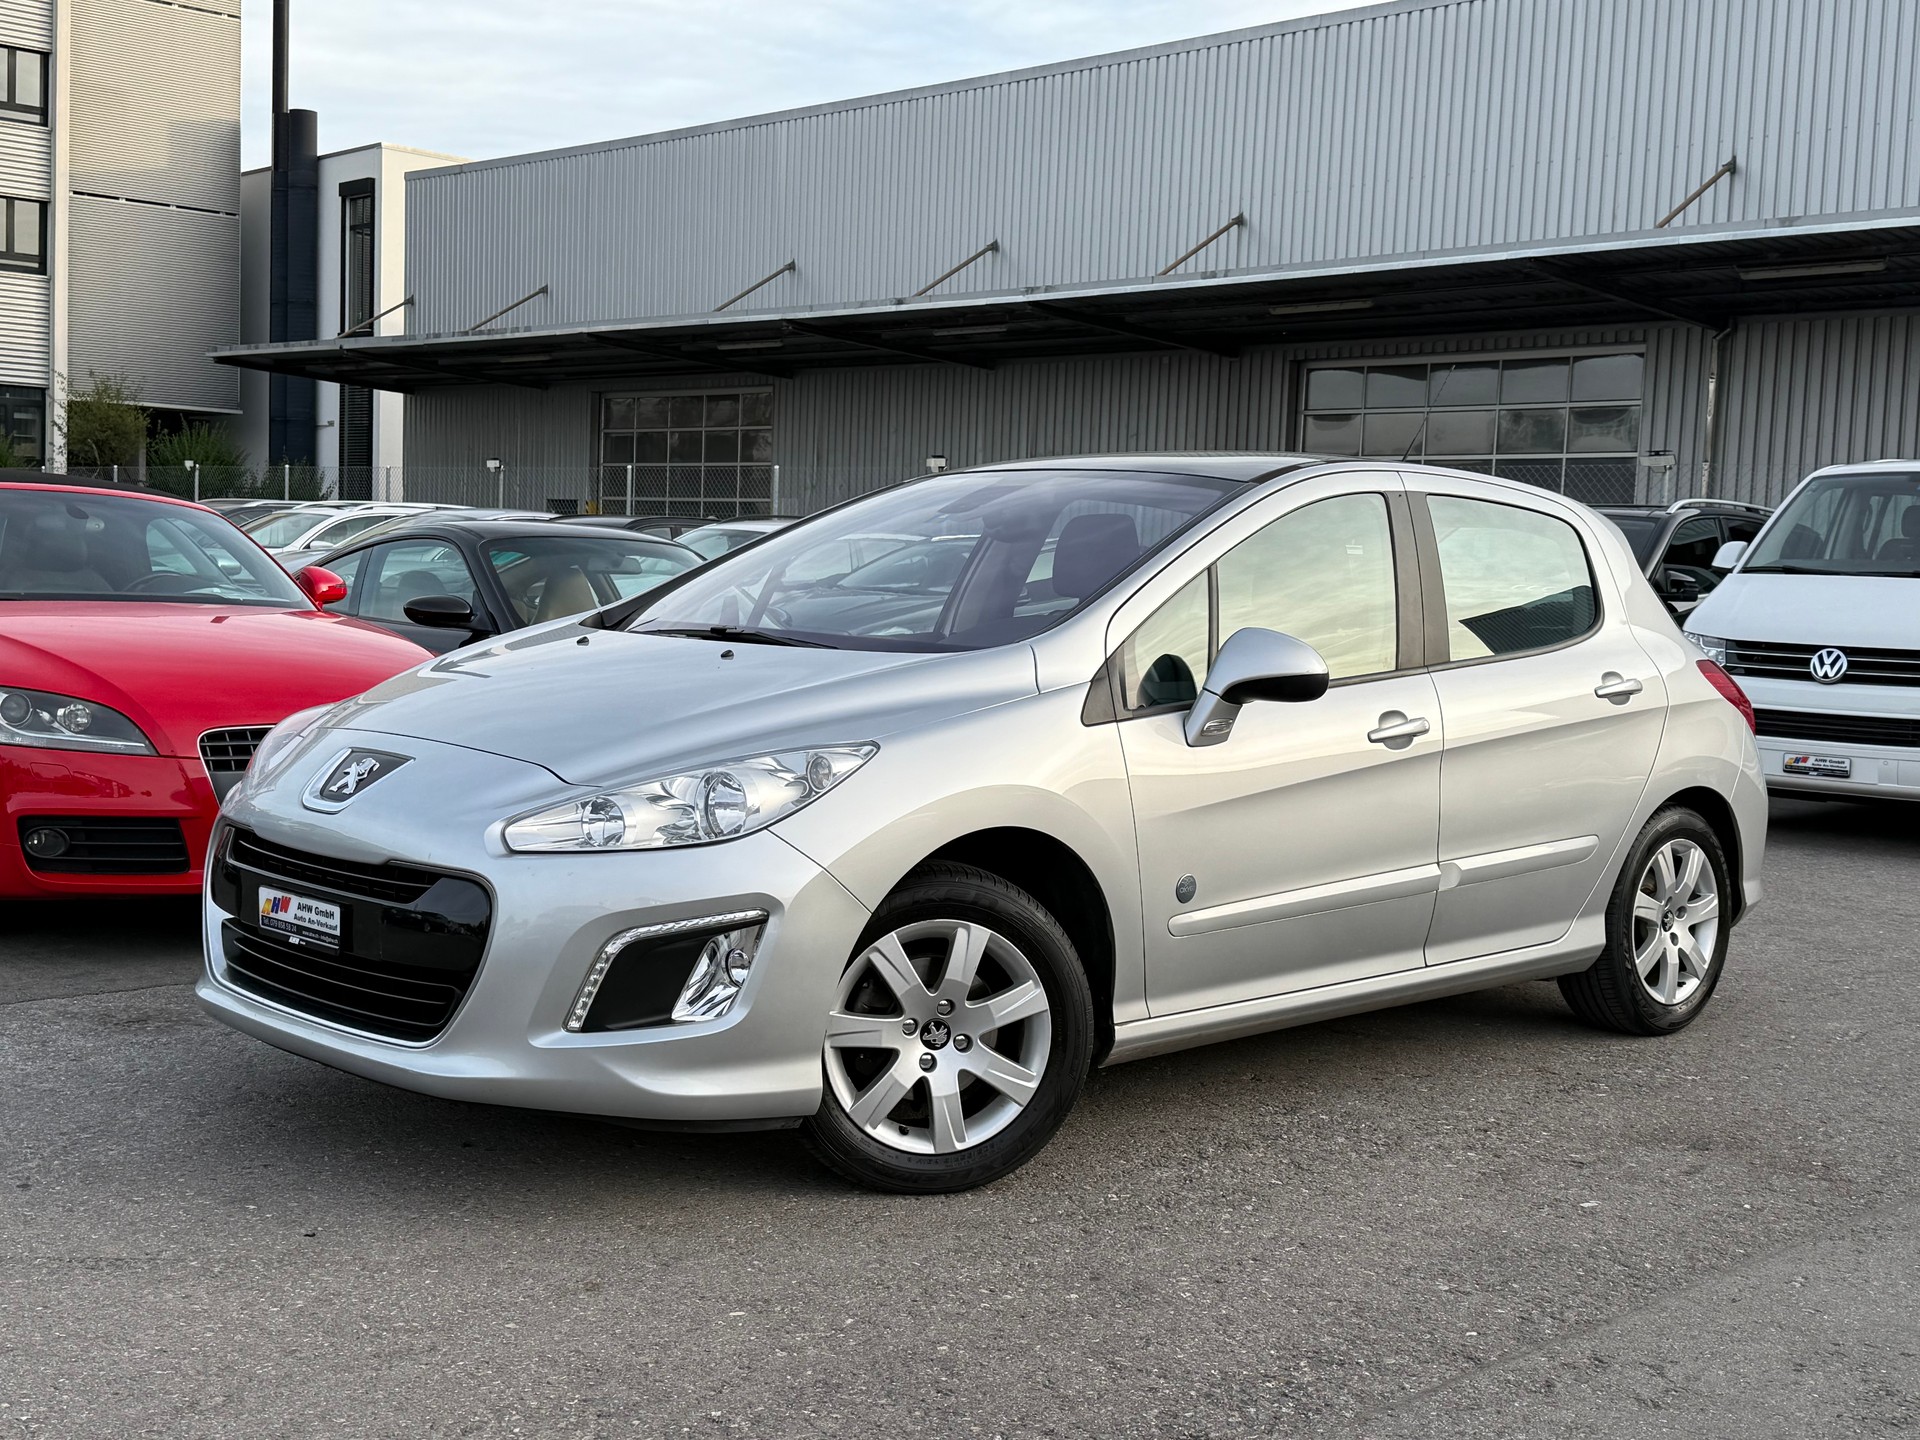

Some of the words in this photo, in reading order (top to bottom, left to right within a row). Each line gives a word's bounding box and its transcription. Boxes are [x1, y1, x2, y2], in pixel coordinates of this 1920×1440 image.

[1810, 648, 1848, 682] VW
[261, 895, 292, 915] AHW
[297, 901, 314, 914] AHW
[314, 906, 335, 920] GmbH
[293, 913, 307, 923] Auto
[307, 917, 338, 931] An-Verkauf
